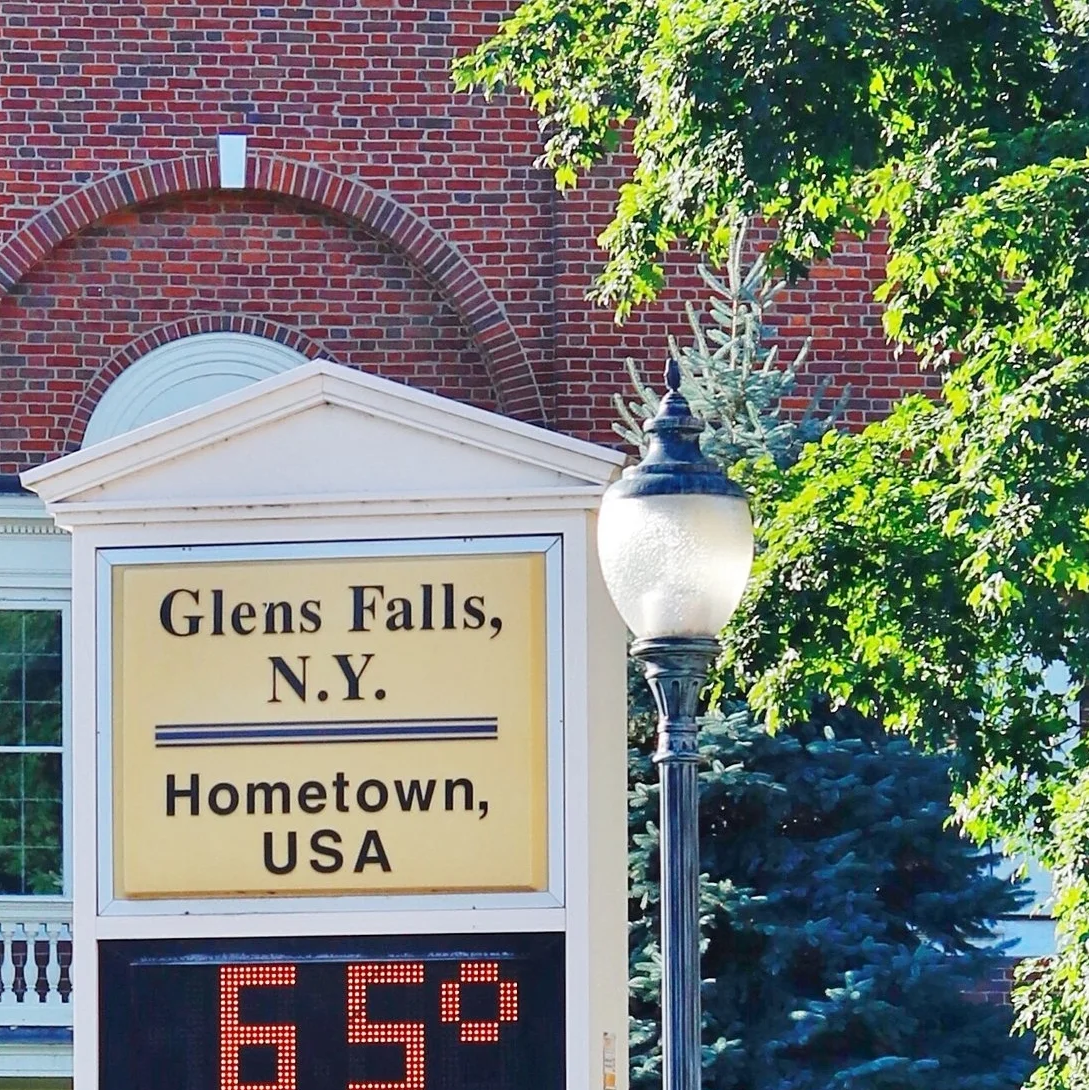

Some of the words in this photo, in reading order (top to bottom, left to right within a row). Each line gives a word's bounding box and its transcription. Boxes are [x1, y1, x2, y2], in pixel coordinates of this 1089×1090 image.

[159, 588, 322, 638] Glens
[348, 583, 503, 639] Falls,
[267, 653, 386, 704] N.Y.
[166, 771, 489, 820] Hometown,
[263, 829, 392, 876] USA
